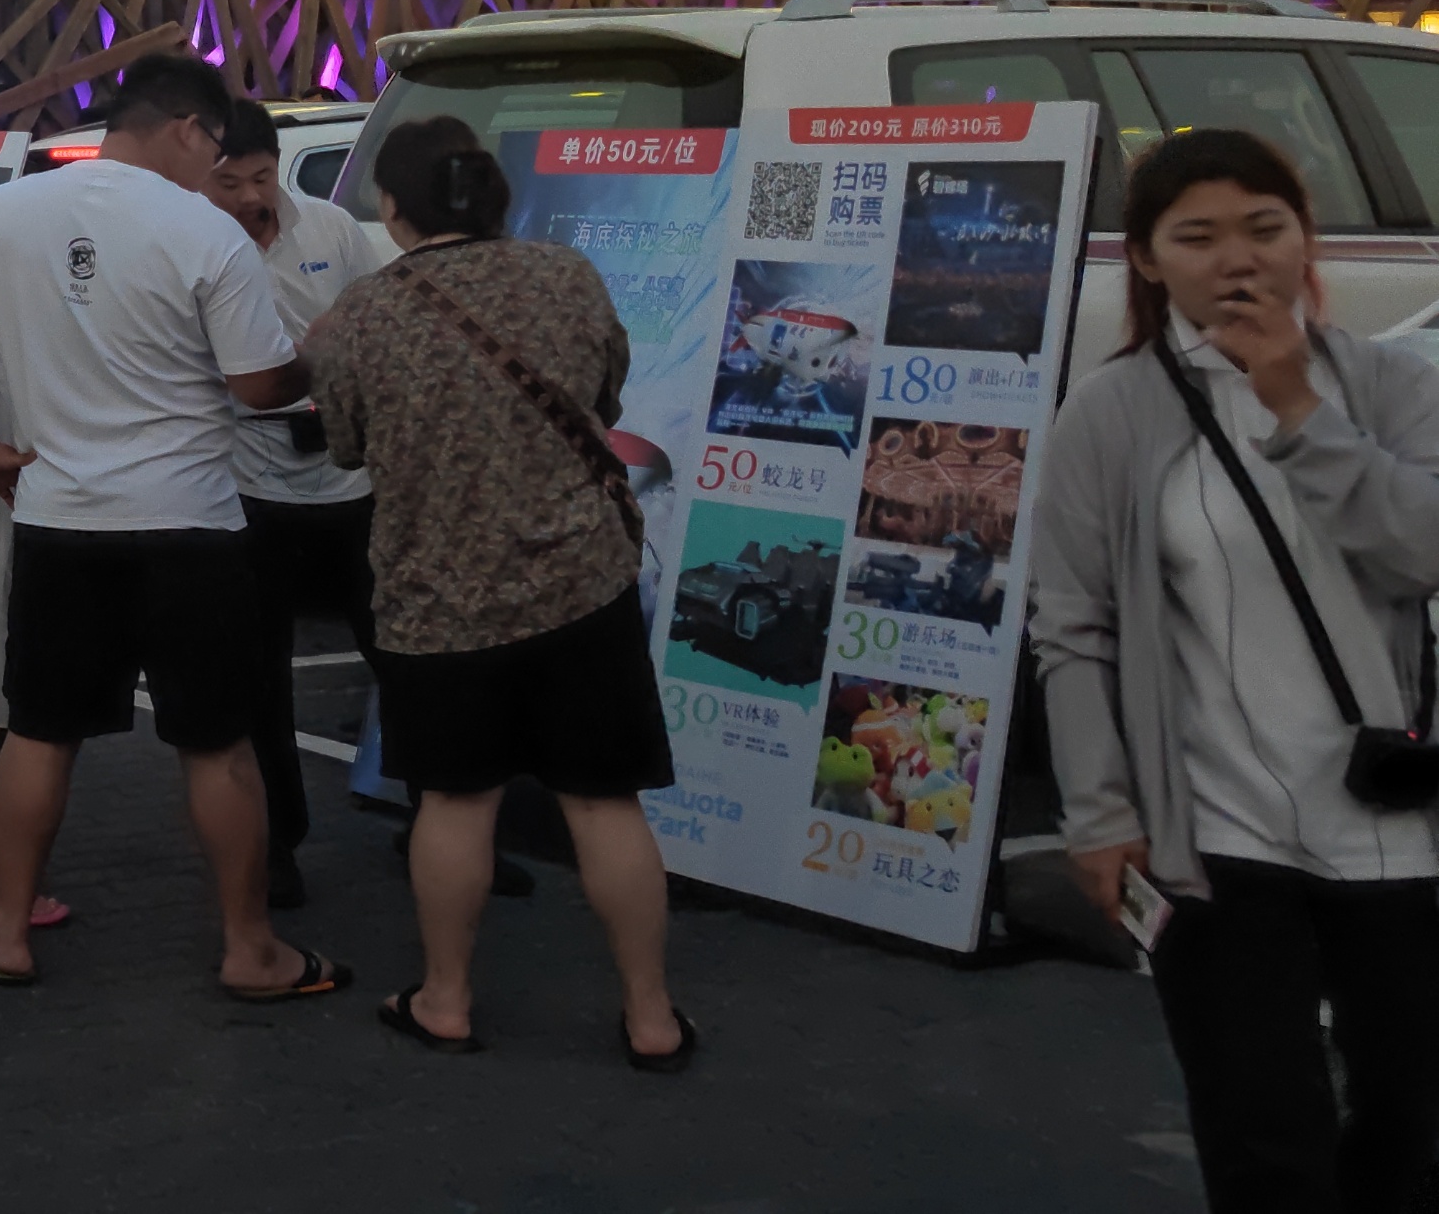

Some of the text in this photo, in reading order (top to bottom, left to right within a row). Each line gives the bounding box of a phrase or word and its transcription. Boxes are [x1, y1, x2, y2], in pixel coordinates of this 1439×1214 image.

[809, 115, 1002, 138] 现价209元 原价310元
[559, 136, 698, 164] 单价50元/位
[832, 161, 888, 192] 扫码
[827, 195, 885, 226] 购票
[572, 221, 705, 254] 海底探秘之旅
[875, 356, 957, 405] 180
[696, 444, 758, 491] 50
[761, 463, 827, 493] 蛟龙号
[837, 611, 899, 660] 30
[902, 621, 957, 650] 游乐场
[663, 685, 719, 733] 30
[723, 701, 780, 728] VR体验
[801, 820, 865, 872] 20
[872, 851, 961, 893] 玩具之恋
